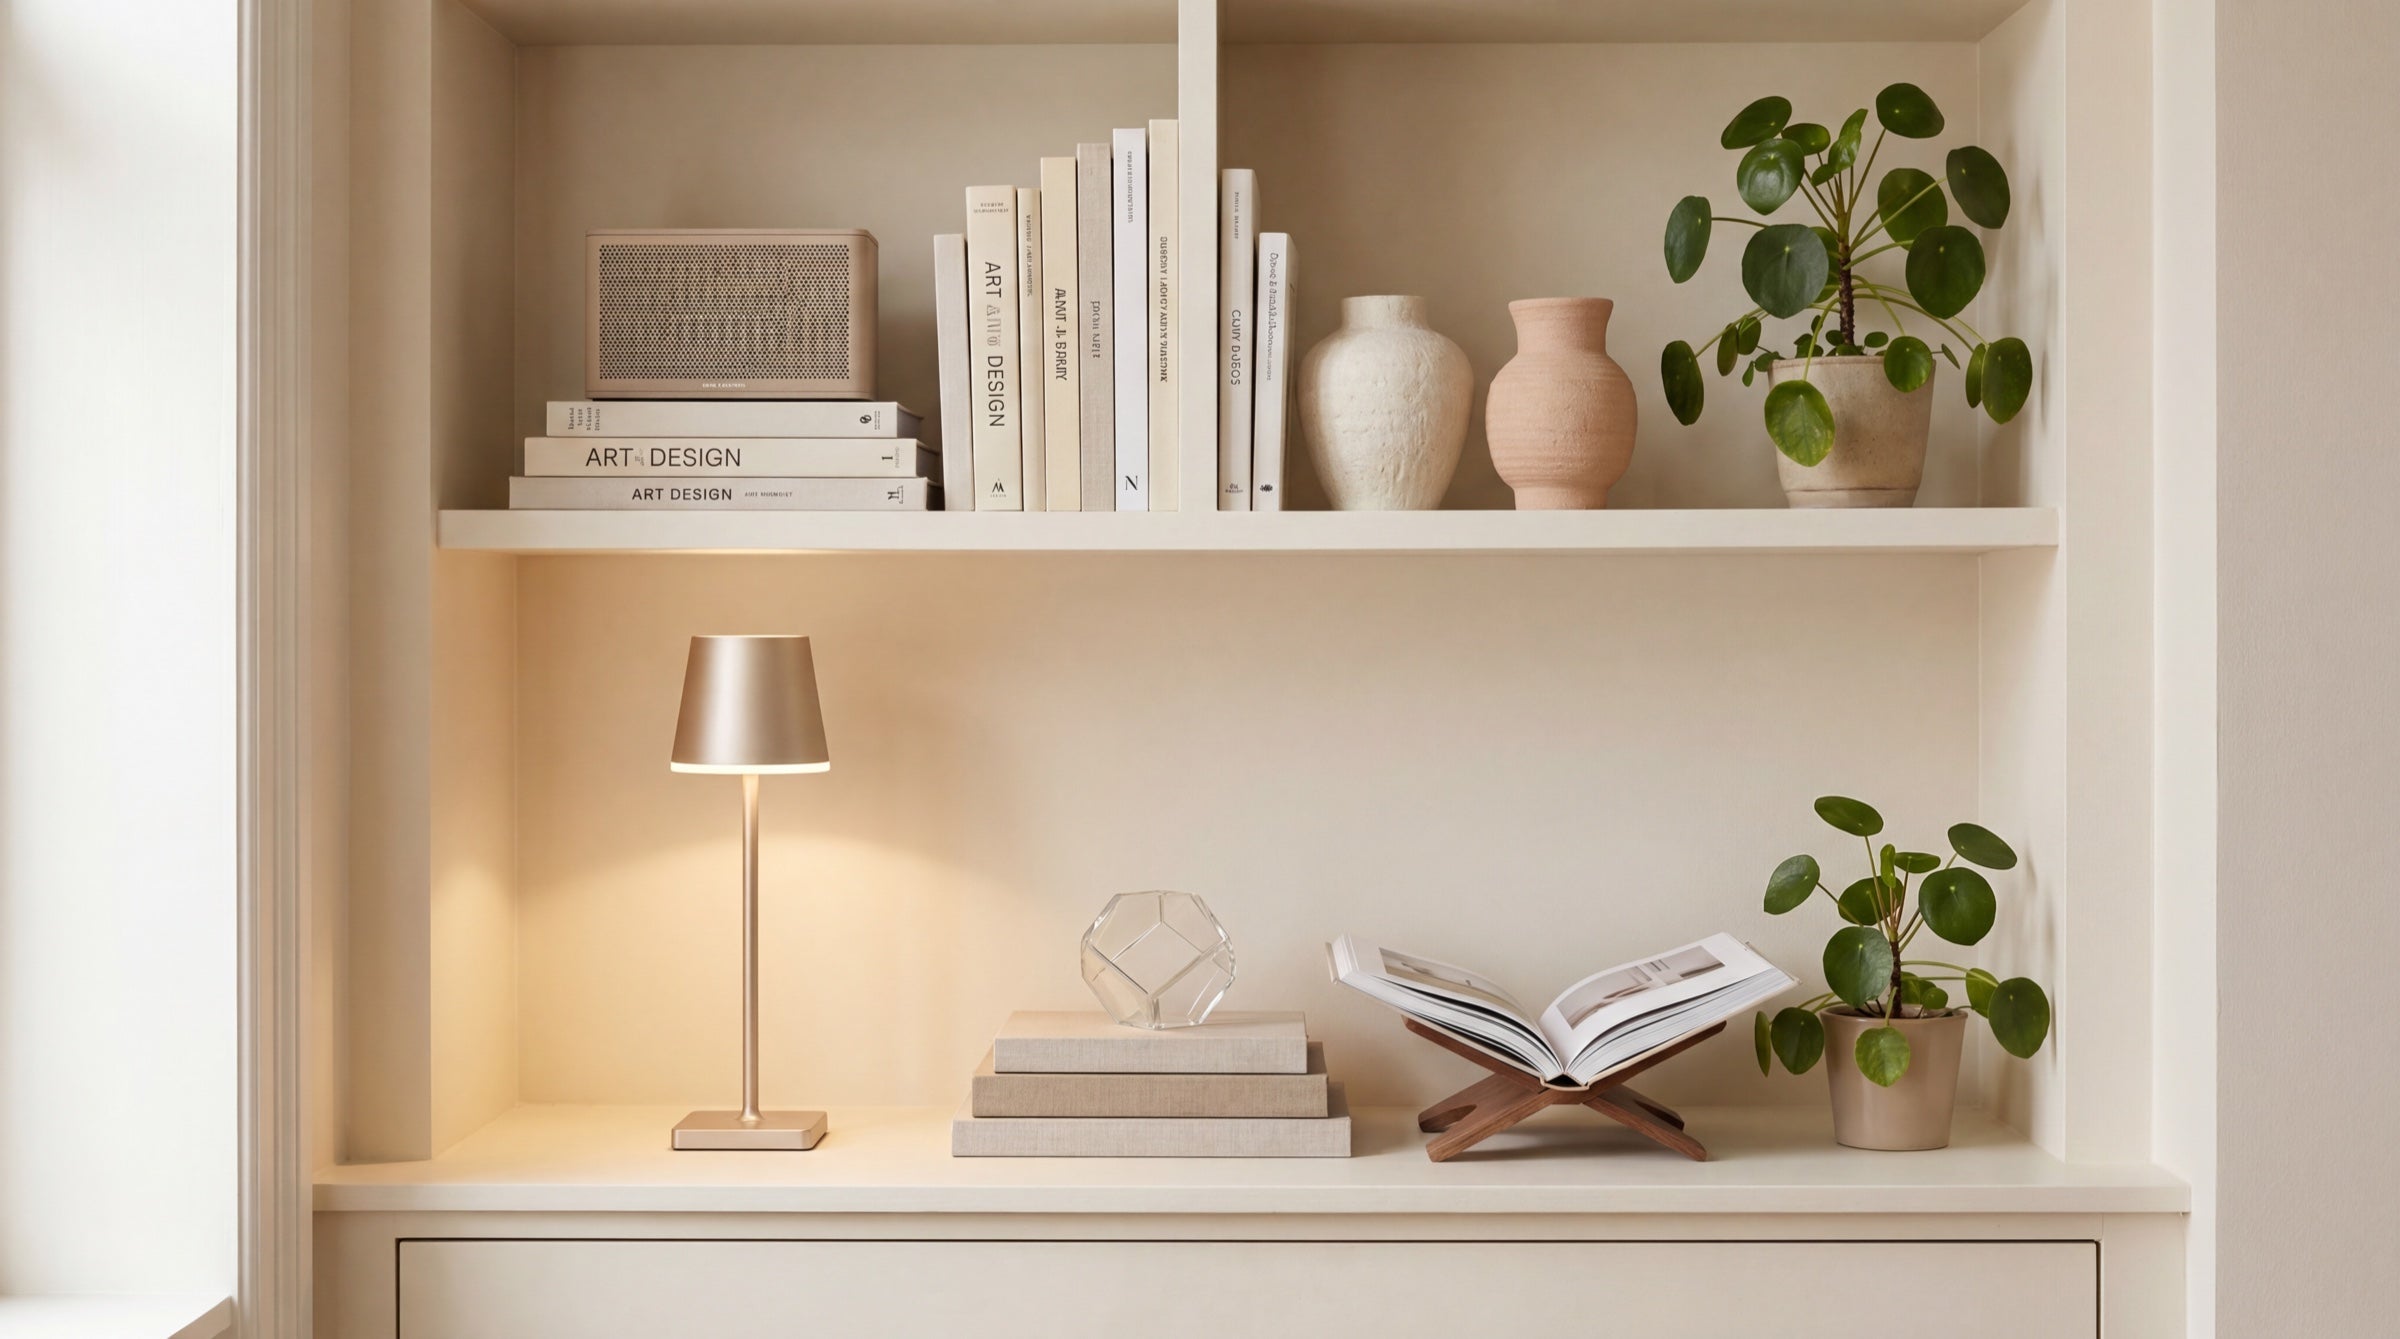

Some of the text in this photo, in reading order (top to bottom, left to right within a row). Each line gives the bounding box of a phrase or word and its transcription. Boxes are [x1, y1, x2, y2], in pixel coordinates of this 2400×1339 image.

[984, 261, 1002, 299] ART
[987, 355, 1006, 427] DESIGN
[584, 447, 634, 468] ART
[650, 447, 741, 468] DESIGN
[1124, 475, 1139, 491] N
[631, 487, 665, 501] ART
[670, 487, 732, 501] DESIGN
